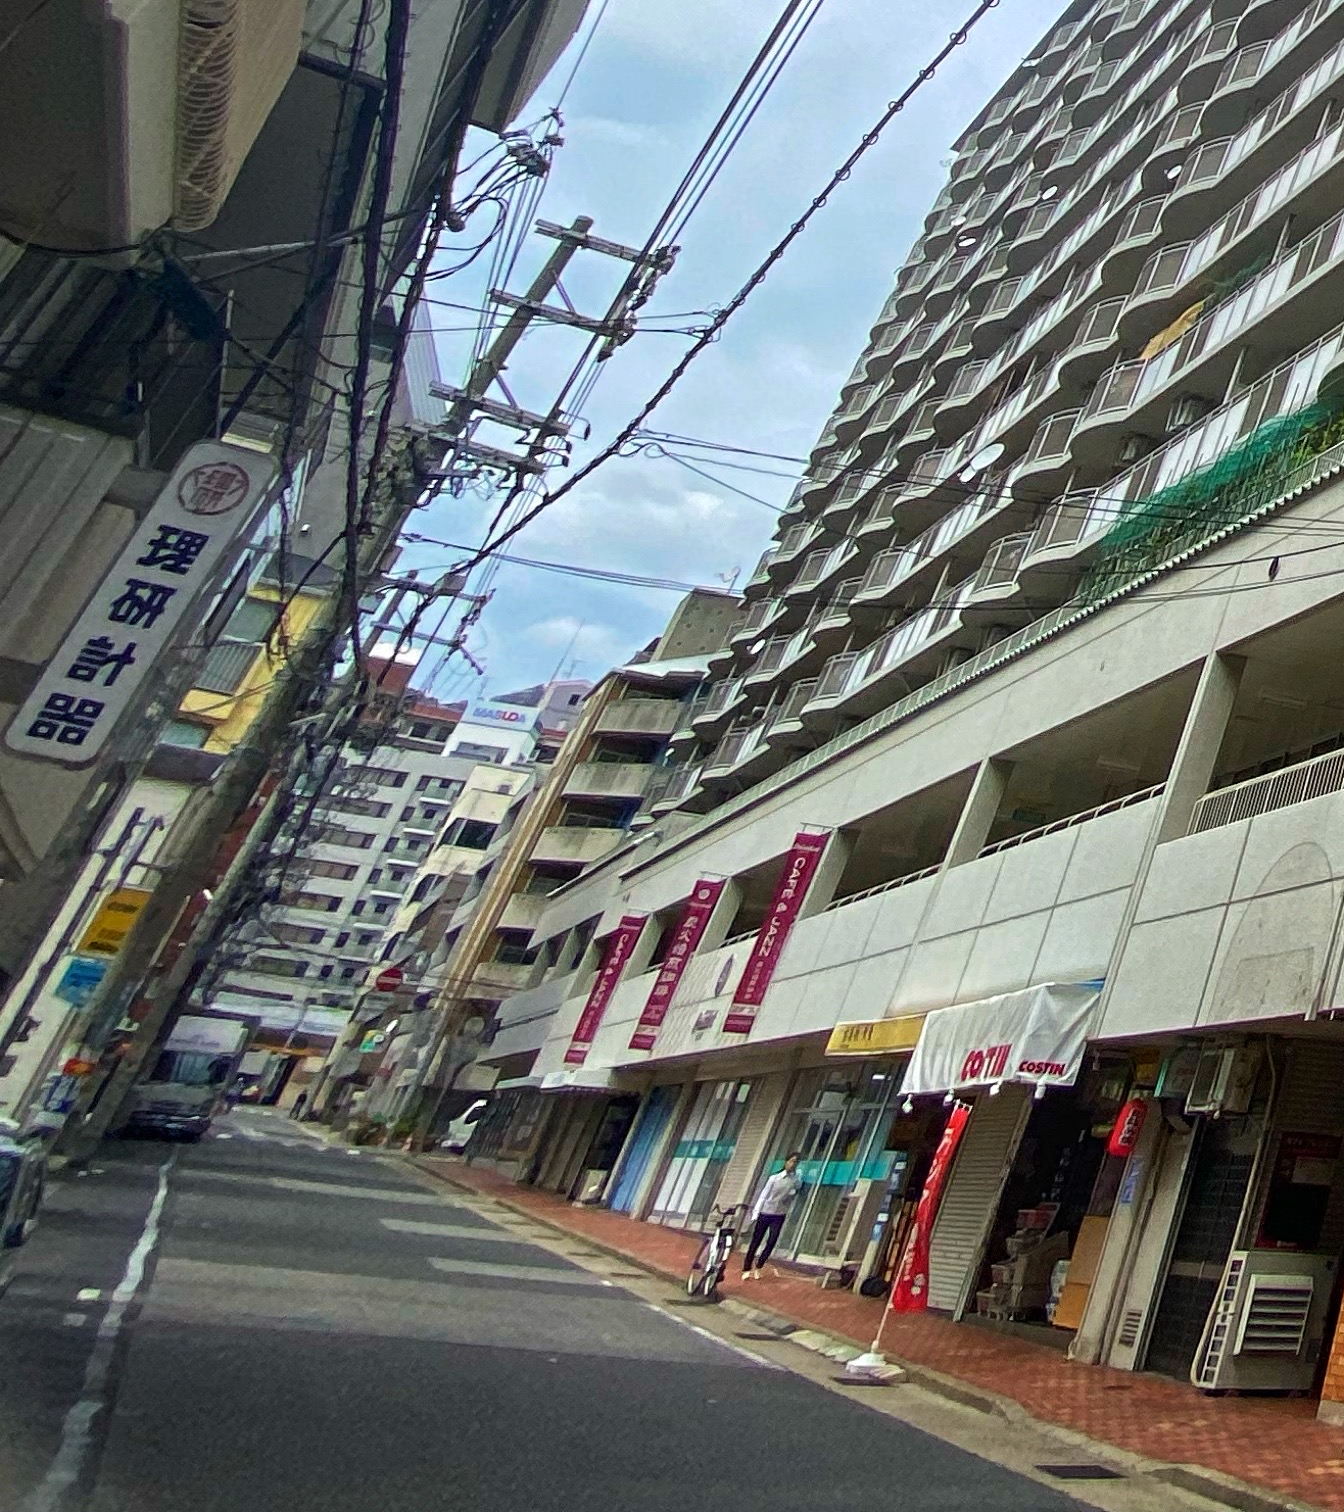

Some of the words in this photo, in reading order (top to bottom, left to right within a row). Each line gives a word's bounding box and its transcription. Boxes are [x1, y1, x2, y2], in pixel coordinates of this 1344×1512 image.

[26, 524, 209, 745] 理研計器
[781, 857, 806, 900] CAFE
[1019, 1060, 1066, 1076] COSTIN
